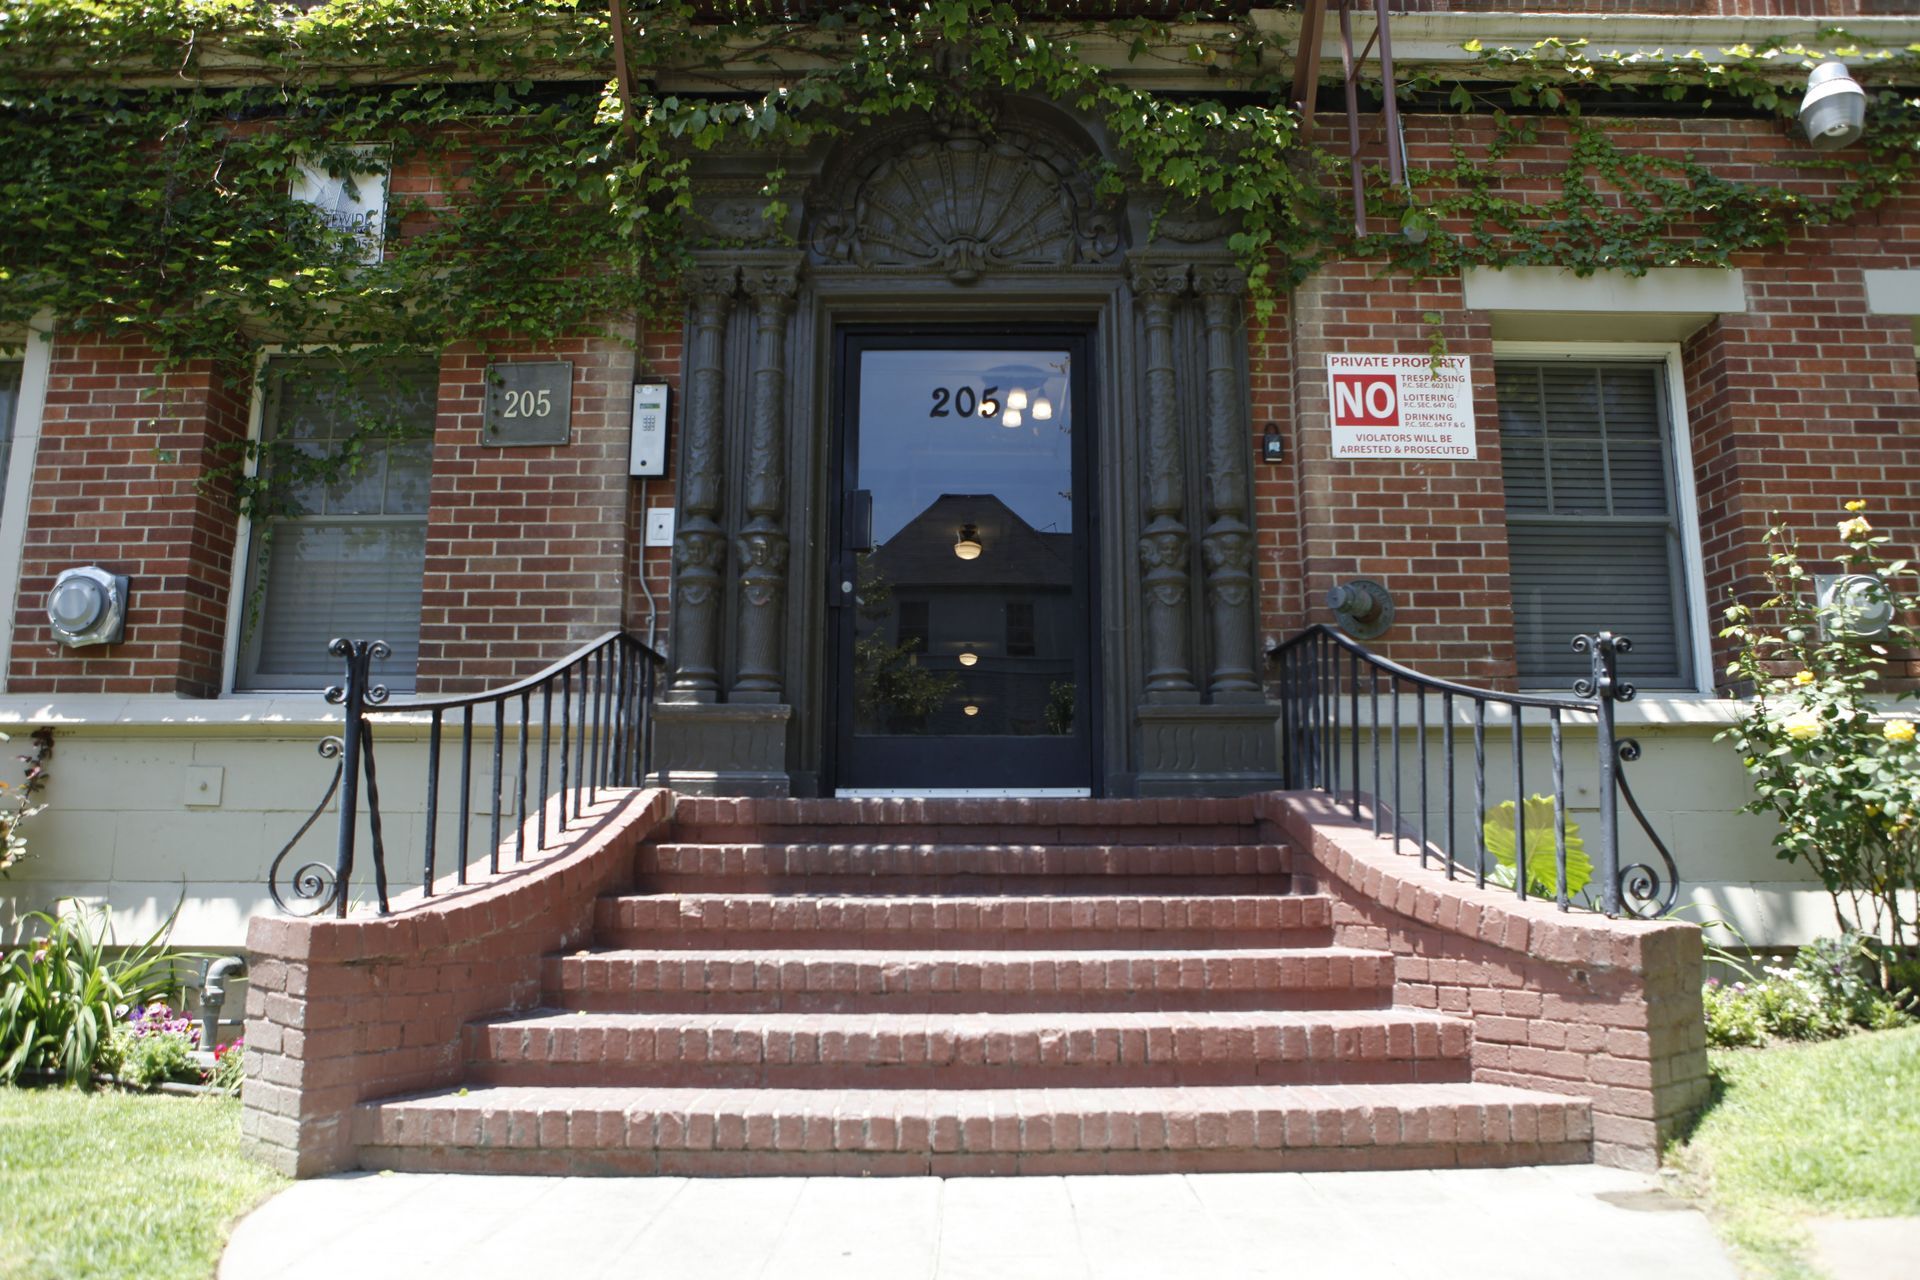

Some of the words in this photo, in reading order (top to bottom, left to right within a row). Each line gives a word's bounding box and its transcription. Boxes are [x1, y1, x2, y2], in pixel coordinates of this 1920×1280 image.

[1331, 356, 1389, 367] PRIVATE
[1392, 356, 1465, 368] PROPRTY
[929, 386, 1001, 418] 205
[1335, 381, 1396, 419] NO
[1403, 393, 1454, 402] LOITERING
[503, 389, 551, 418] 205
[1404, 413, 1453, 421] DRINKING
[1356, 434, 1412, 442] VIOLATORS
[1413, 434, 1438, 443] WILL
[1440, 434, 1453, 443] BE
[1340, 445, 1392, 454] ARRESTED
[1394, 445, 1401, 454] &
[1404, 445, 1469, 455] PROSECUTED
